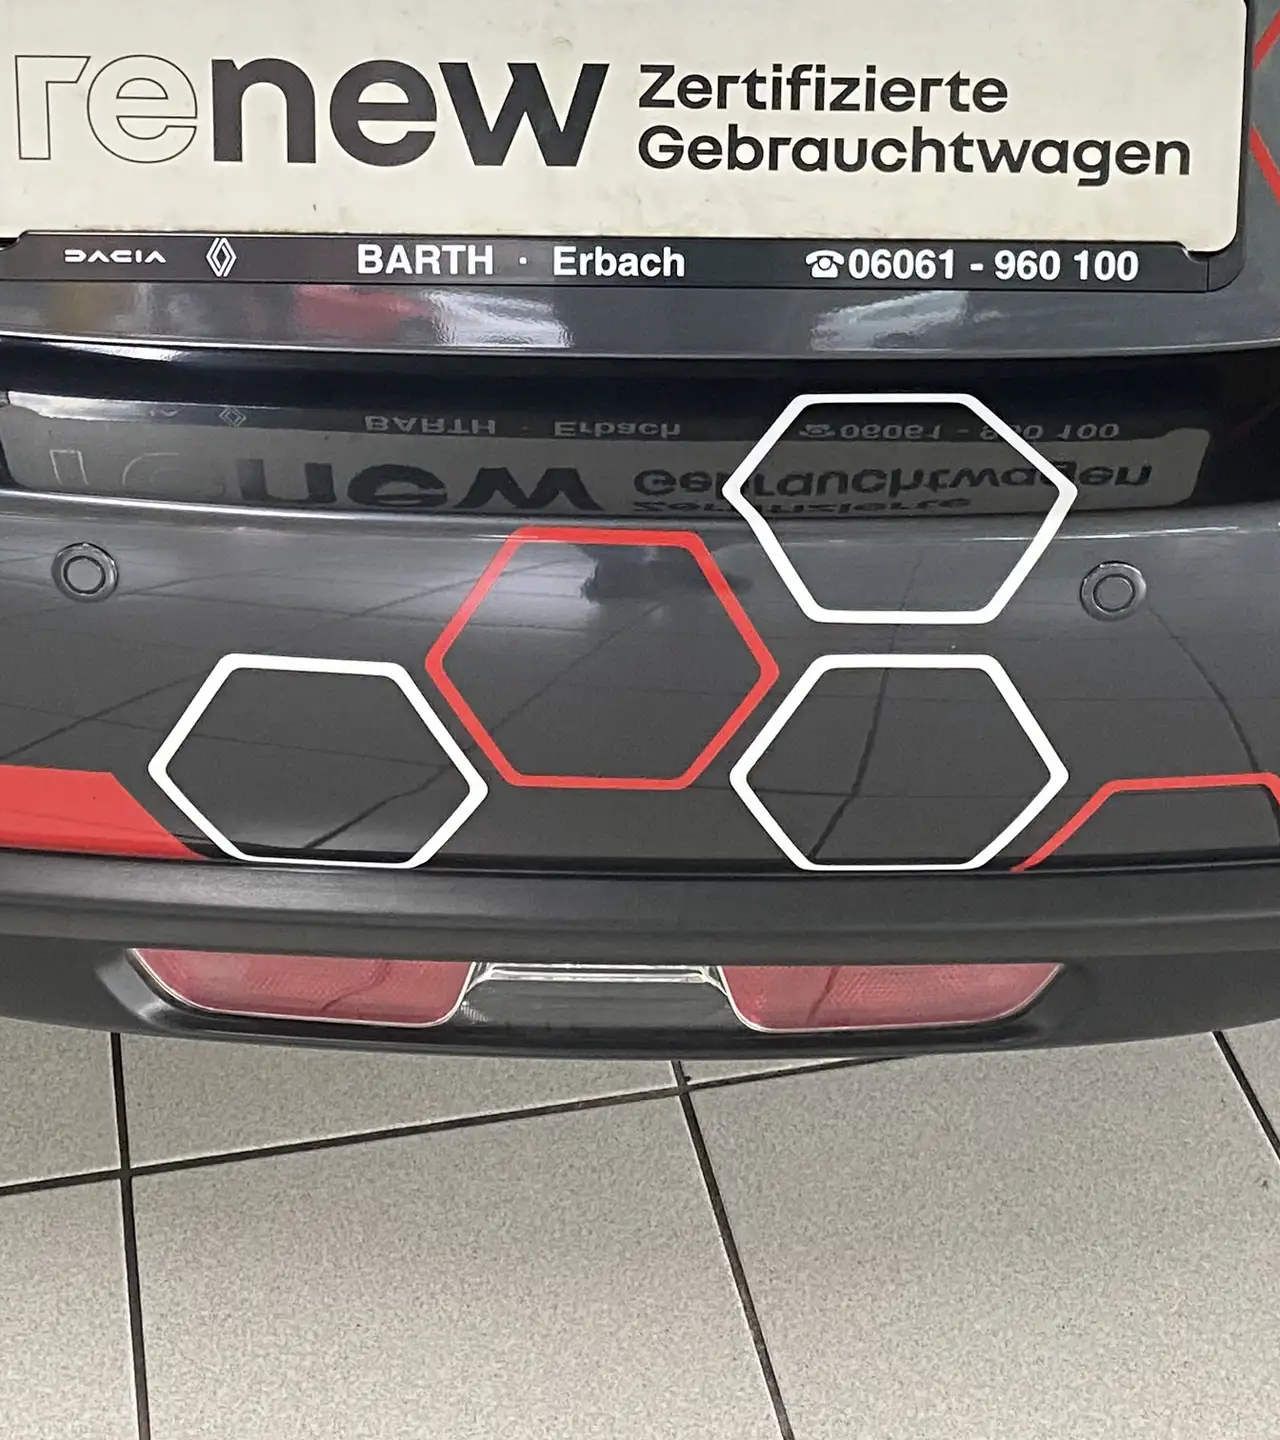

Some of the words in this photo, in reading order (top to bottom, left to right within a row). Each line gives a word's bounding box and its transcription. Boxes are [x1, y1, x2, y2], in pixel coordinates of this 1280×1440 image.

[639, 64, 1008, 113] Zertifizierte
[14, 54, 610, 167] renew
[638, 123, 1191, 187] Gebrauchtwagen
[64, 249, 167, 263] DACIA
[357, 244, 494, 276] BARTH
[553, 245, 685, 279] Erbach
[848, 250, 956, 281] 06061
[994, 250, 1062, 282] 960
[1075, 251, 1139, 282] 100
